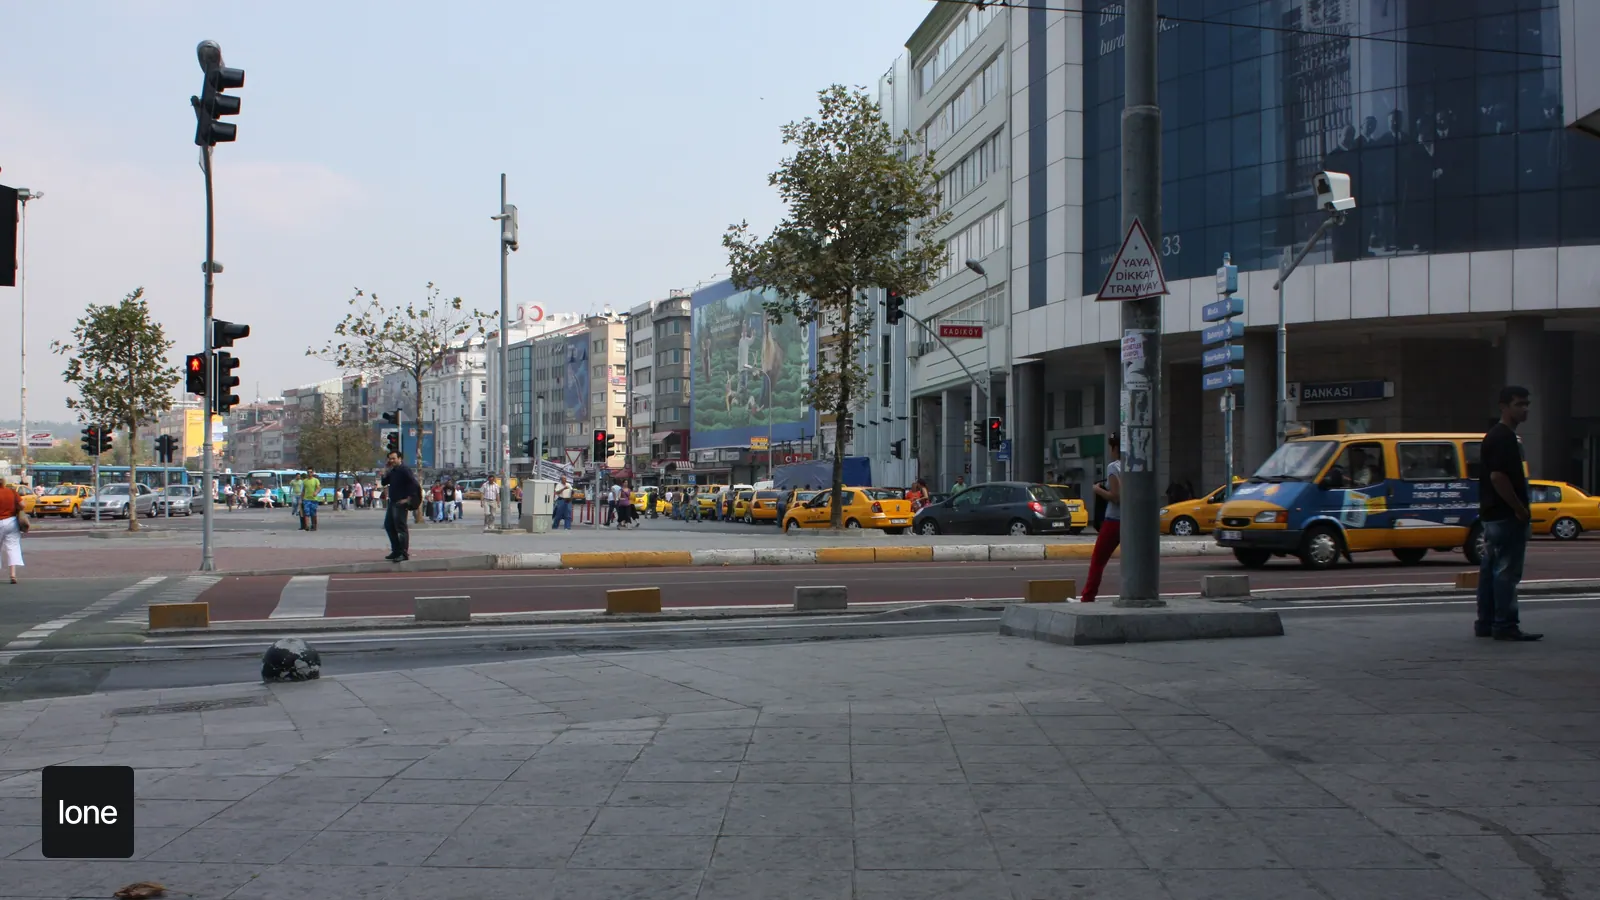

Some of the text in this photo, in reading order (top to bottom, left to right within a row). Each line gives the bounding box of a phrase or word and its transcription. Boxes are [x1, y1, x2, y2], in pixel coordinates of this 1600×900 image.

[1123, 258, 1151, 268] YAYA
[1116, 269, 1155, 281] DİKKAT
[1109, 281, 1159, 294] TRAMVAY
[1303, 386, 1354, 399] BANKASI
